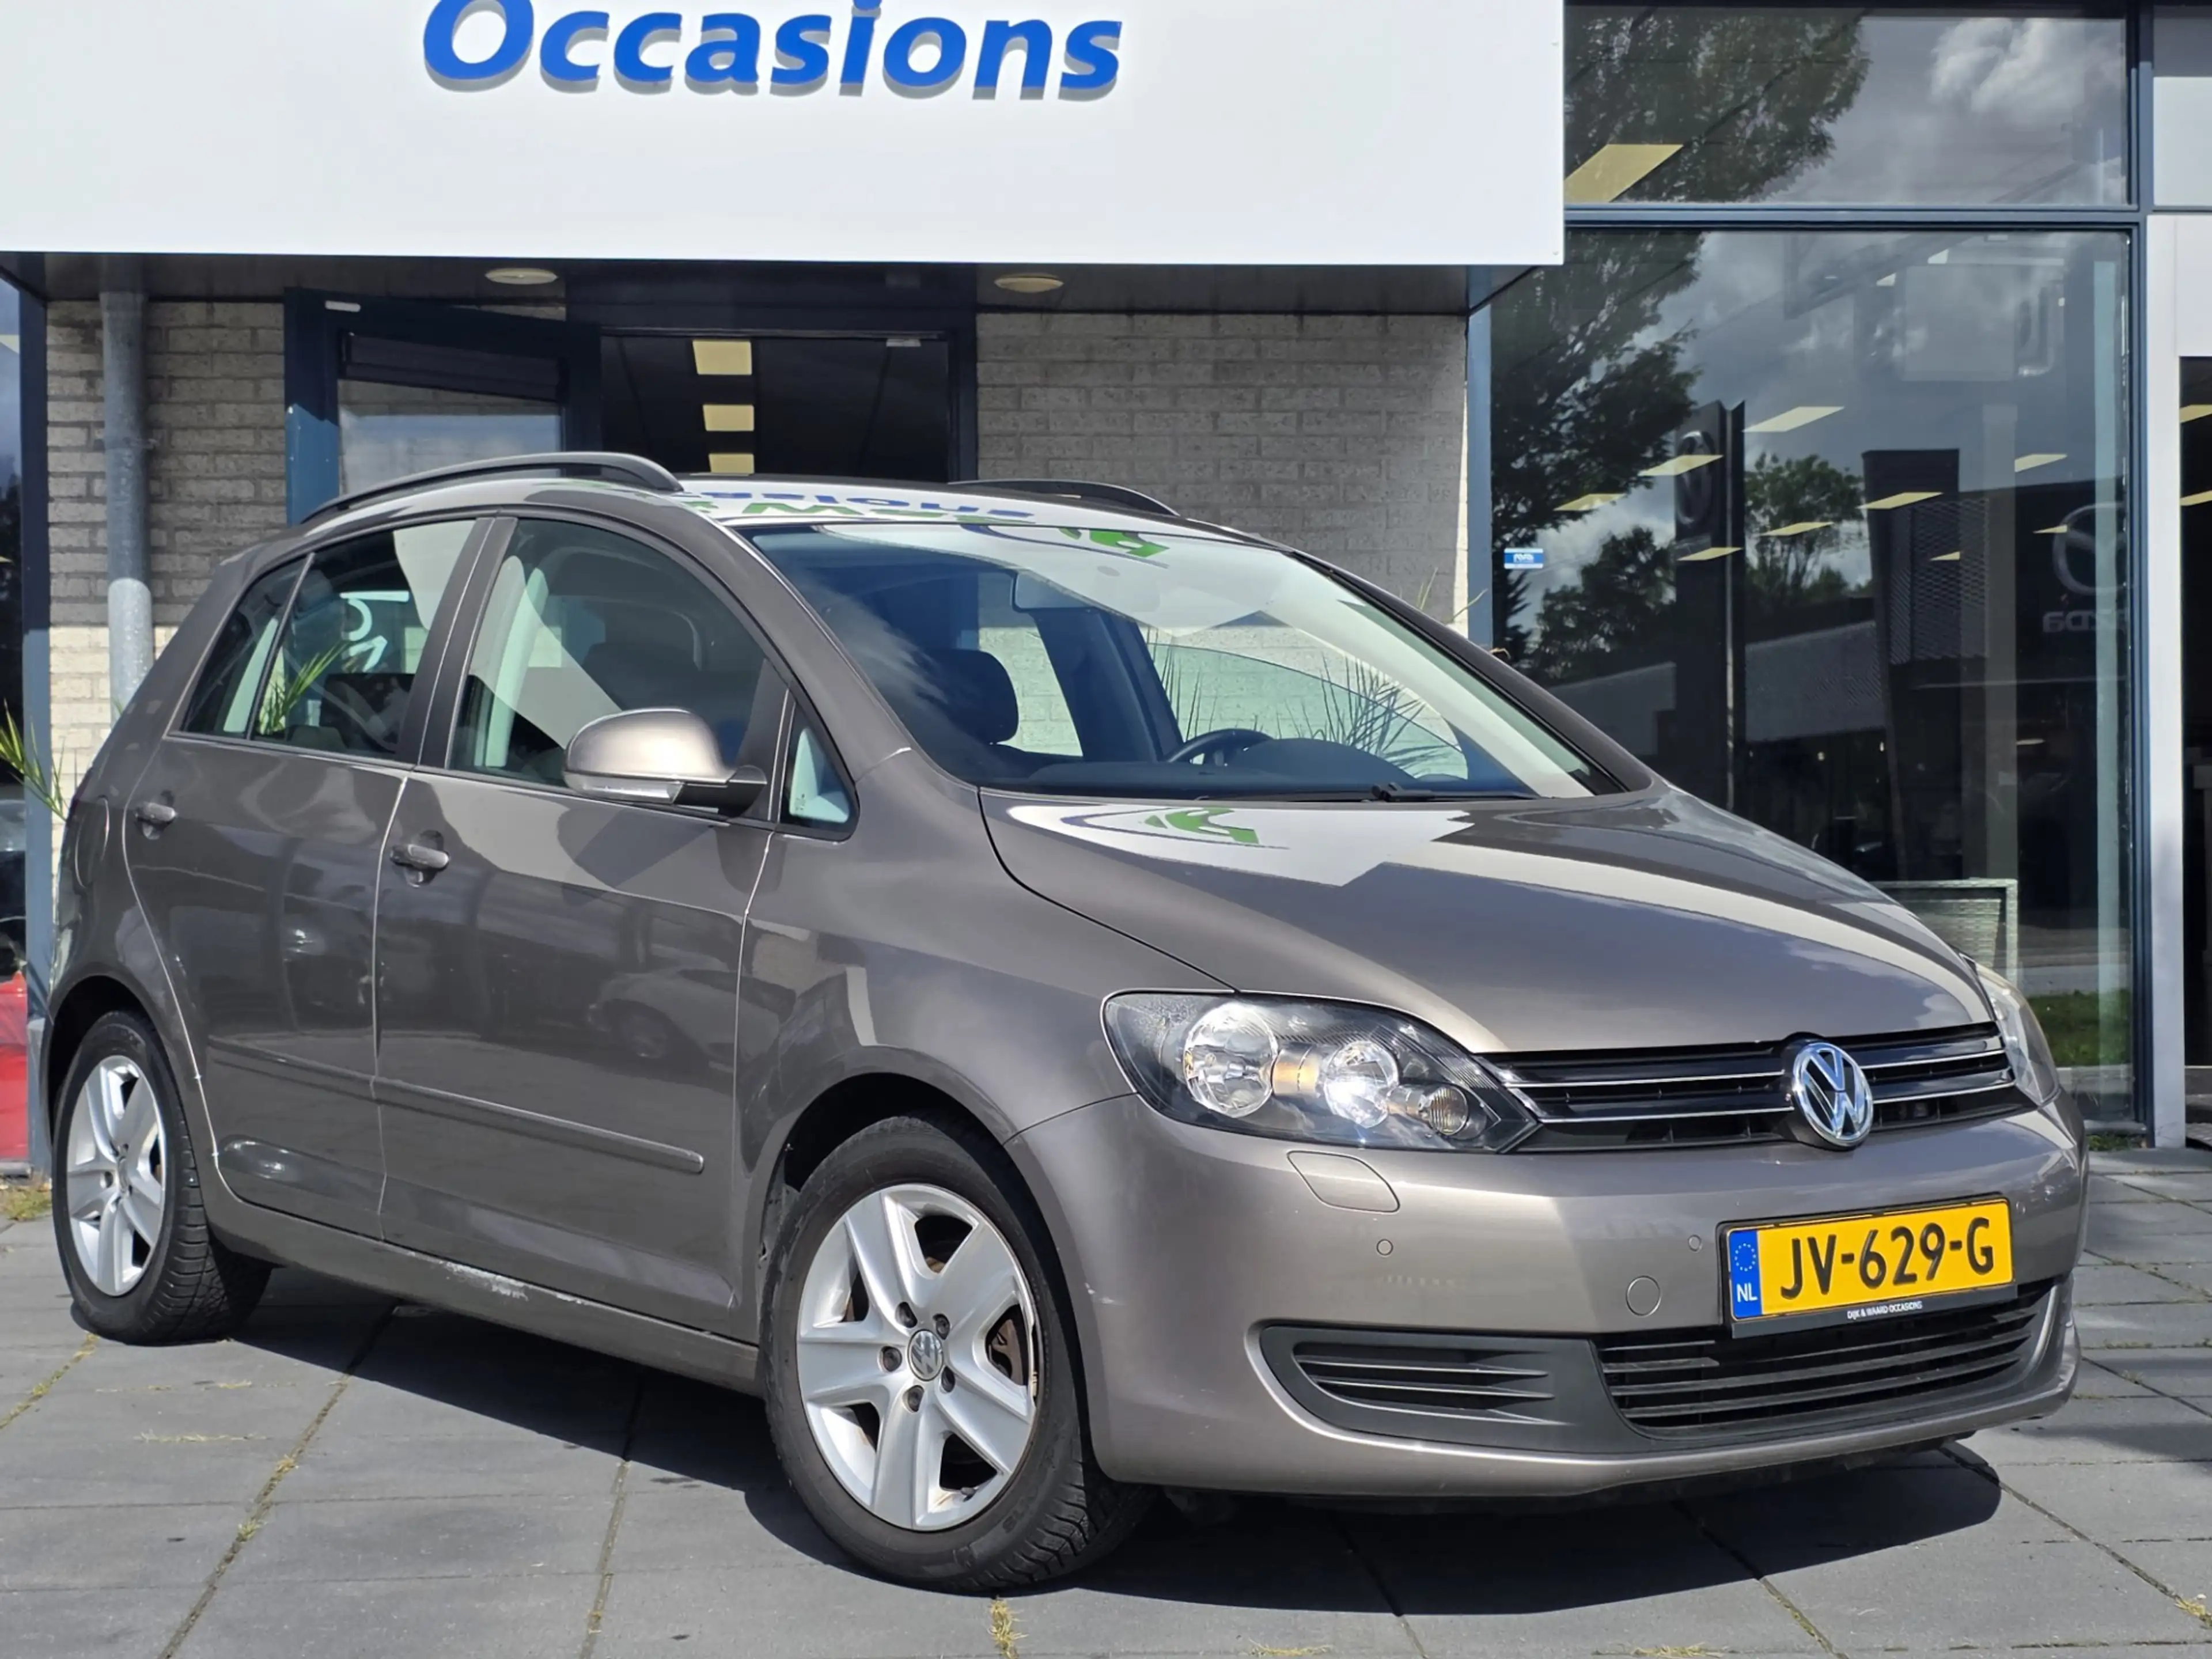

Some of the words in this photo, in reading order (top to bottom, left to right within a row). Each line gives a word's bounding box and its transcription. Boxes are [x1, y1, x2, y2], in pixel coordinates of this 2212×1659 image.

[422, 0, 1124, 94] Occasions
[1780, 1217, 1995, 1300] JV-629-G
[1736, 1282, 1758, 1302] NL
[1889, 1301, 1923, 1312] OCCASIONS
